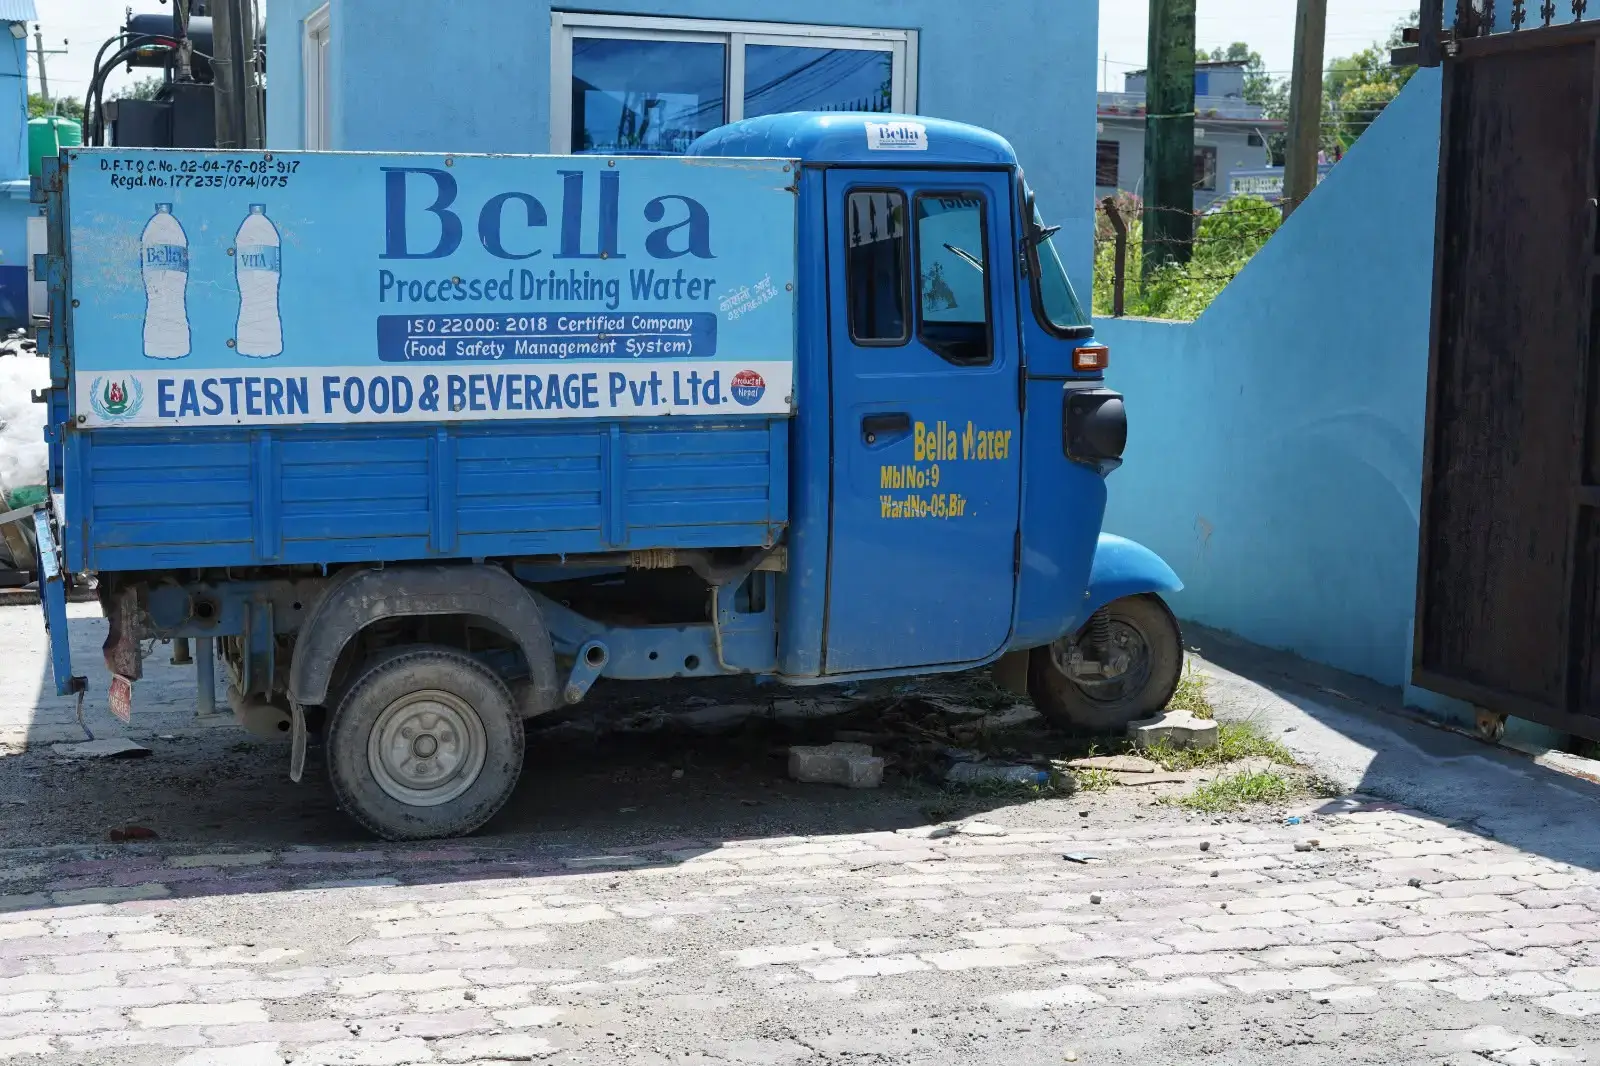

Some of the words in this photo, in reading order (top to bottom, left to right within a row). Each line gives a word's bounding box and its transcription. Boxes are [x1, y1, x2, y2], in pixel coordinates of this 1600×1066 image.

[879, 127, 919, 139] Bella
[379, 166, 718, 260] Bella
[241, 254, 267, 268] VITA
[379, 269, 514, 303] Processed
[519, 269, 620, 311] Drinking
[629, 268, 716, 301] Water
[407, 319, 436, 333] ISO
[440, 318, 500, 333] 22000:
[505, 317, 548, 332] 2018
[557, 315, 625, 332] Certified
[631, 315, 693, 334] Company
[403, 340, 446, 359] (Food
[456, 339, 504, 359] Safety
[514, 339, 617, 358] Management
[625, 337, 693, 356] System)
[157, 376, 309, 417] EASTERN
[322, 375, 413, 414] FOOD
[418, 374, 440, 412] &
[447, 372, 600, 412] BEVERAGE
[608, 371, 668, 408] Pvt.
[672, 370, 728, 406] Ltd.
[914, 420, 957, 461] Bella
